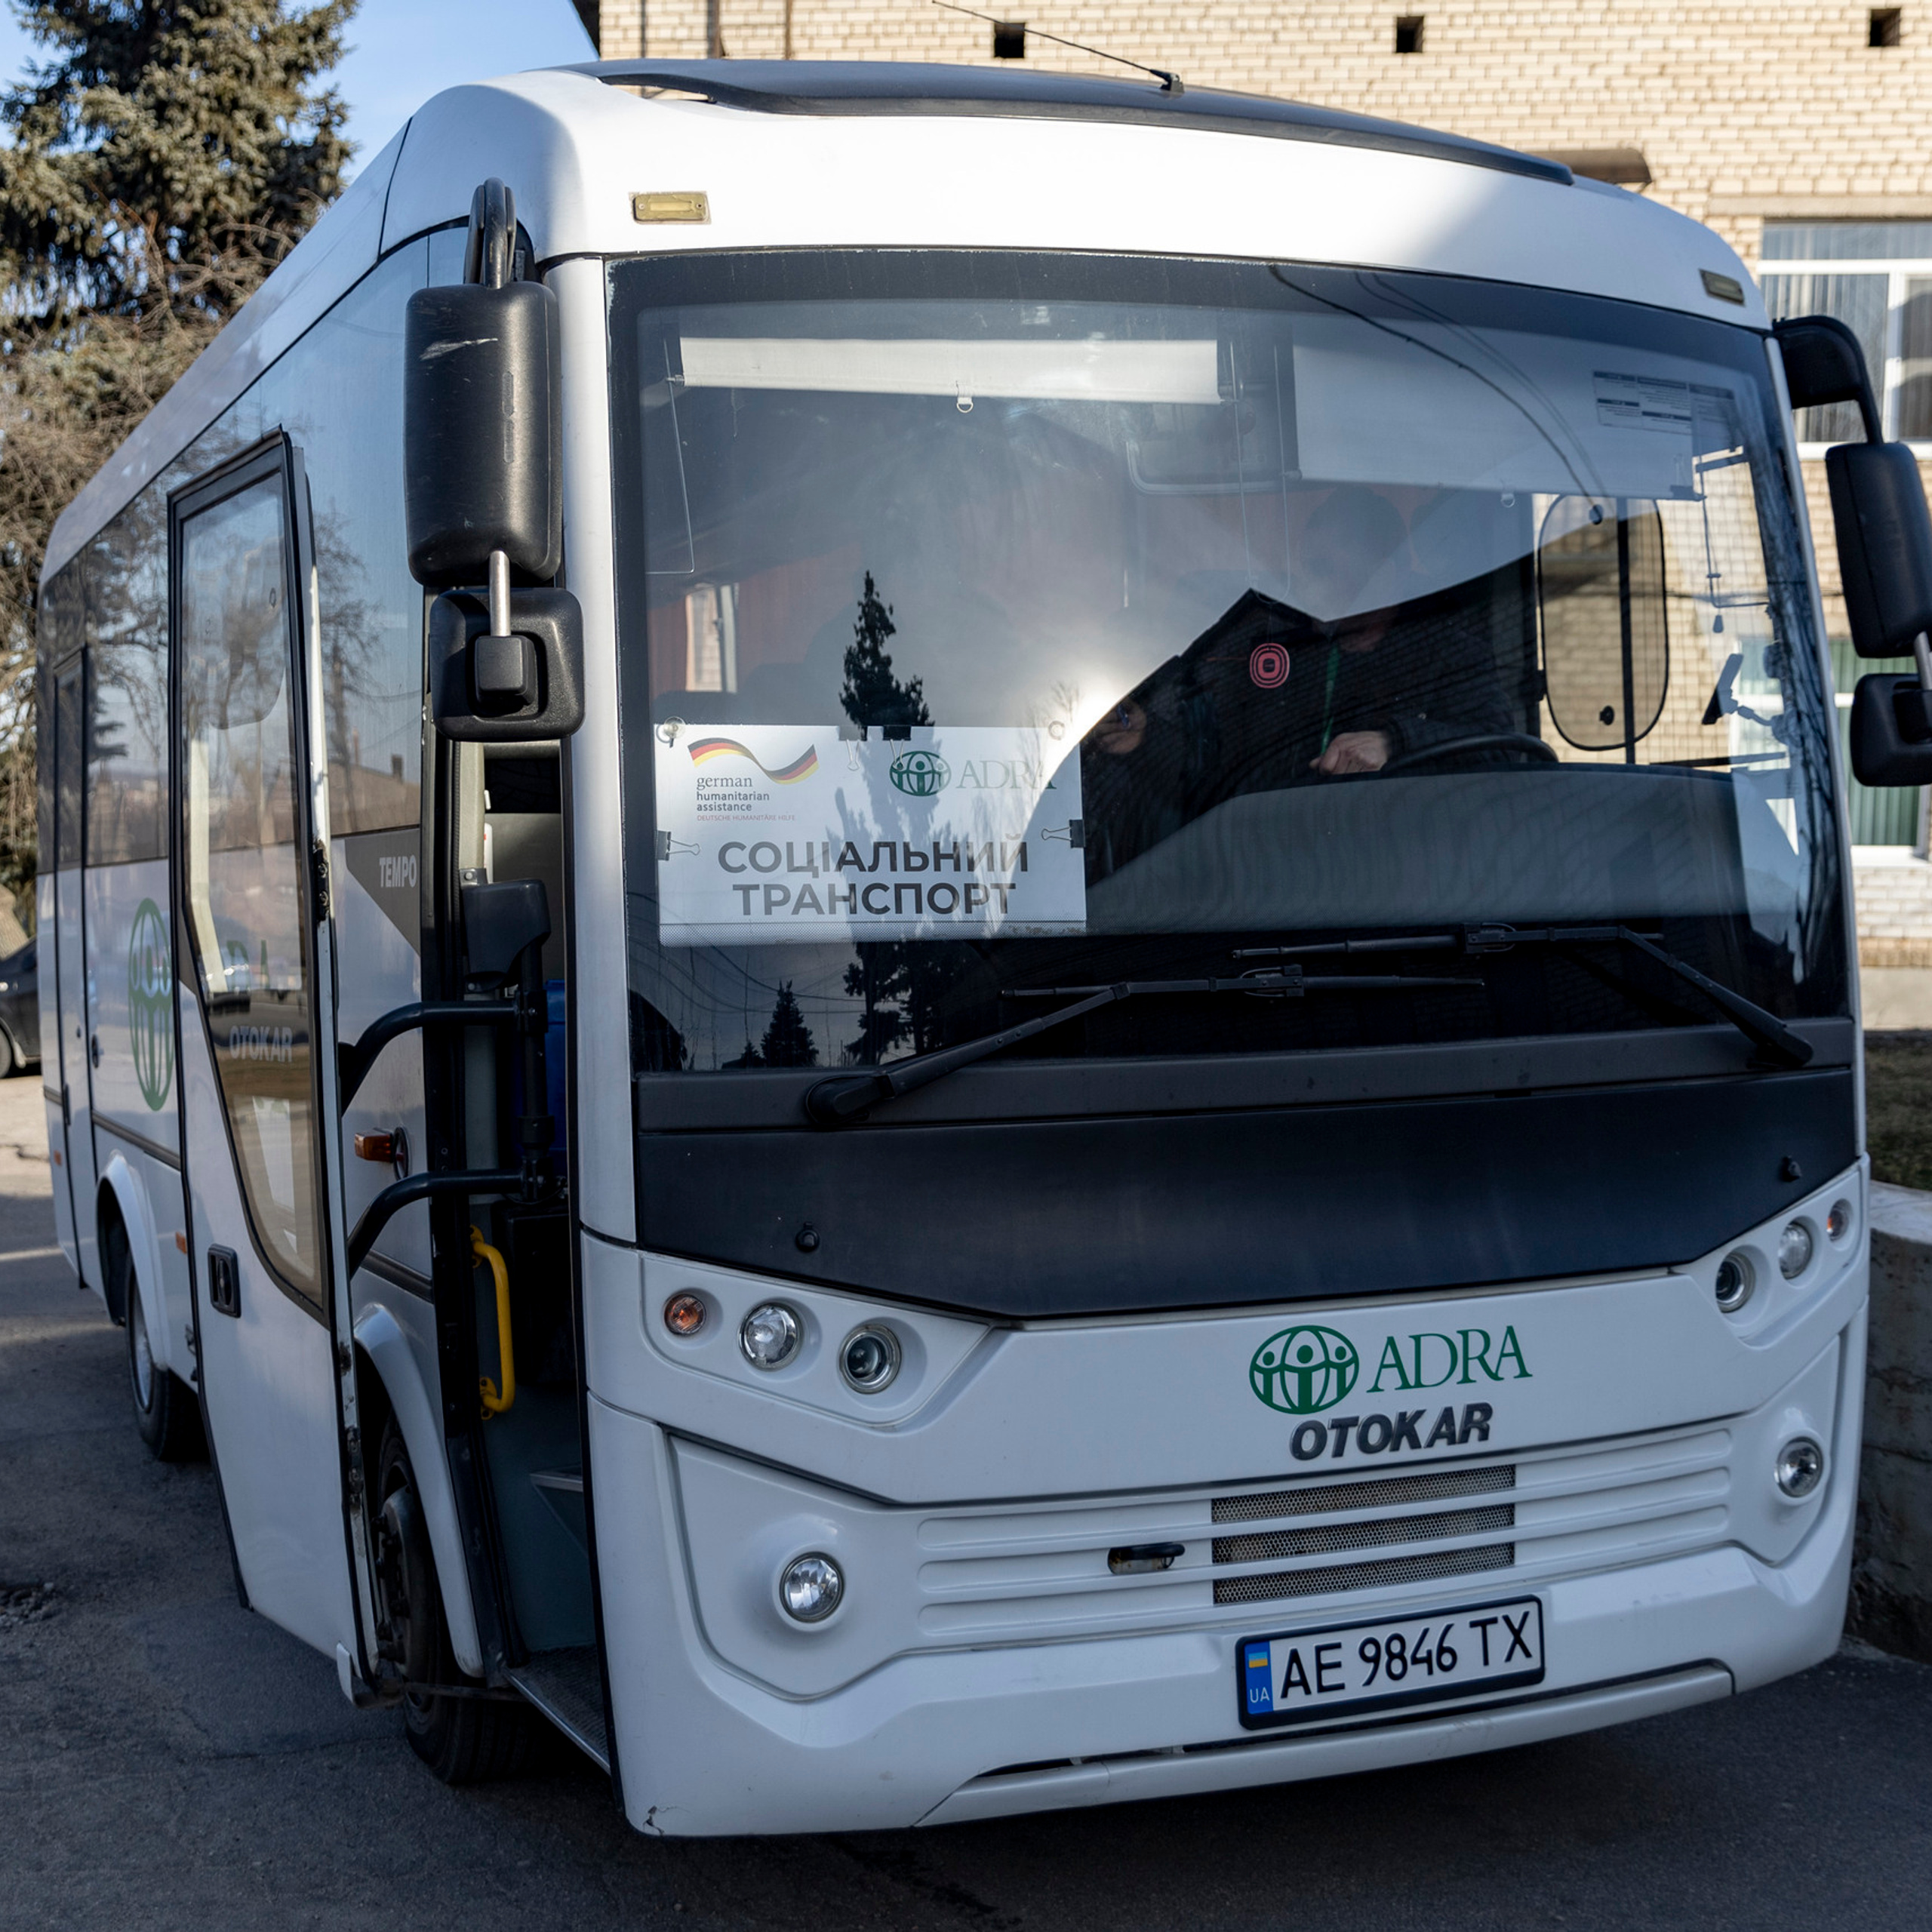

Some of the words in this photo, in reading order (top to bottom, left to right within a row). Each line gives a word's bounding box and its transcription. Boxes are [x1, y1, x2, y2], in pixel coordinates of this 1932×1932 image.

[697, 777, 752, 790] german
[955, 760, 1057, 789] ADRA
[697, 791, 770, 801] humanitarian
[697, 801, 752, 811] assistance
[379, 854, 417, 888] TEMPO
[718, 834, 1028, 878] СОЦІАЛЬНИЙ
[733, 882, 1017, 915] ТРАНСПОРТ
[229, 1025, 293, 1063] OTOKAR
[1366, 1325, 1533, 1393] ADRA
[1290, 1402, 1494, 1460] OTOKAR
[1280, 1641, 1345, 1699] AE
[1358, 1623, 1457, 1687] 9846
[1469, 1611, 1533, 1666] TX
[1249, 1687, 1270, 1703] UA
